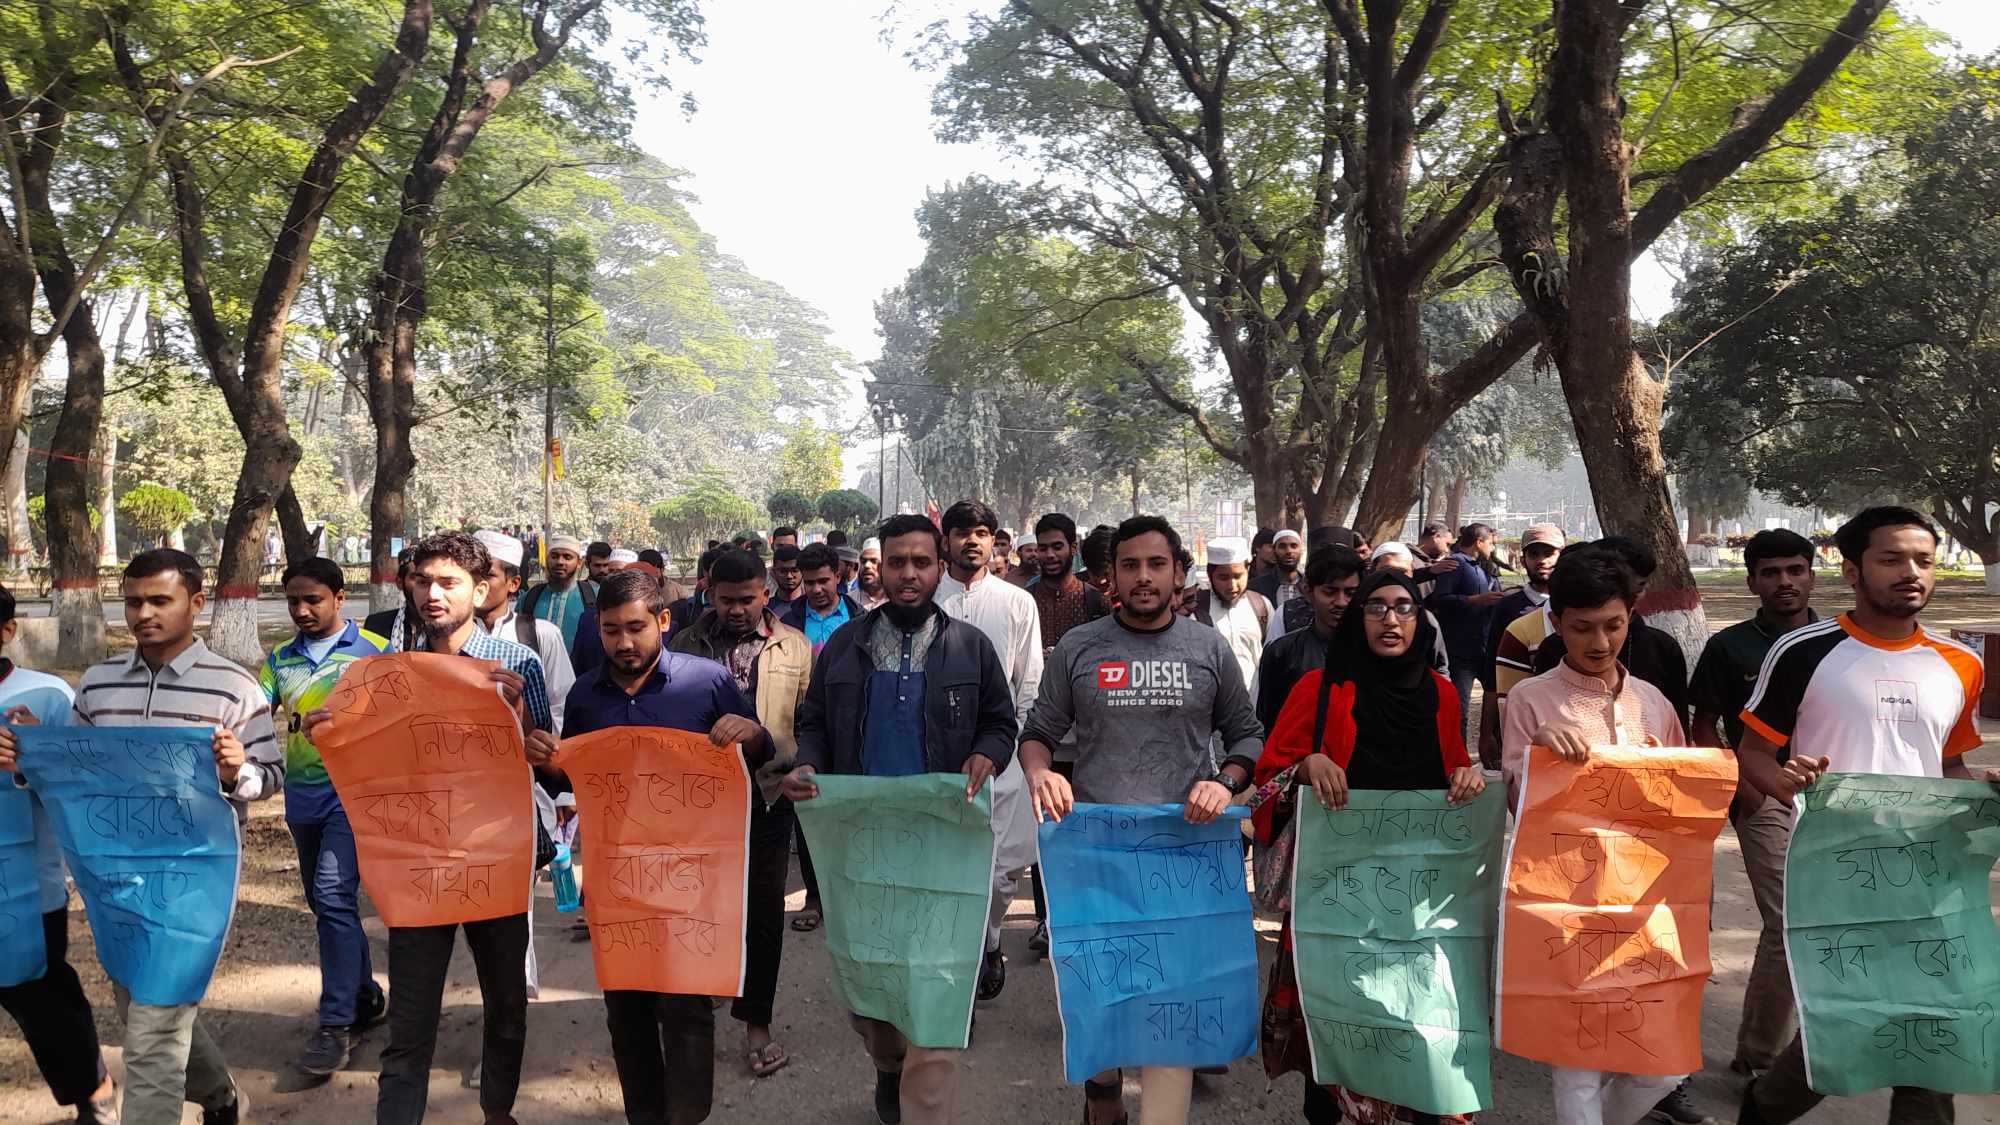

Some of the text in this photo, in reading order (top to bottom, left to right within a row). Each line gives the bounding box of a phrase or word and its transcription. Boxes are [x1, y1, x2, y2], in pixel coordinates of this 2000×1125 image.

[1131, 661, 1193, 690] DIESEL
[1107, 689, 1183, 697] NEW STYLE
[1107, 698, 1184, 706] SINCE 2020
[1880, 697, 1912, 705] NOKIA
